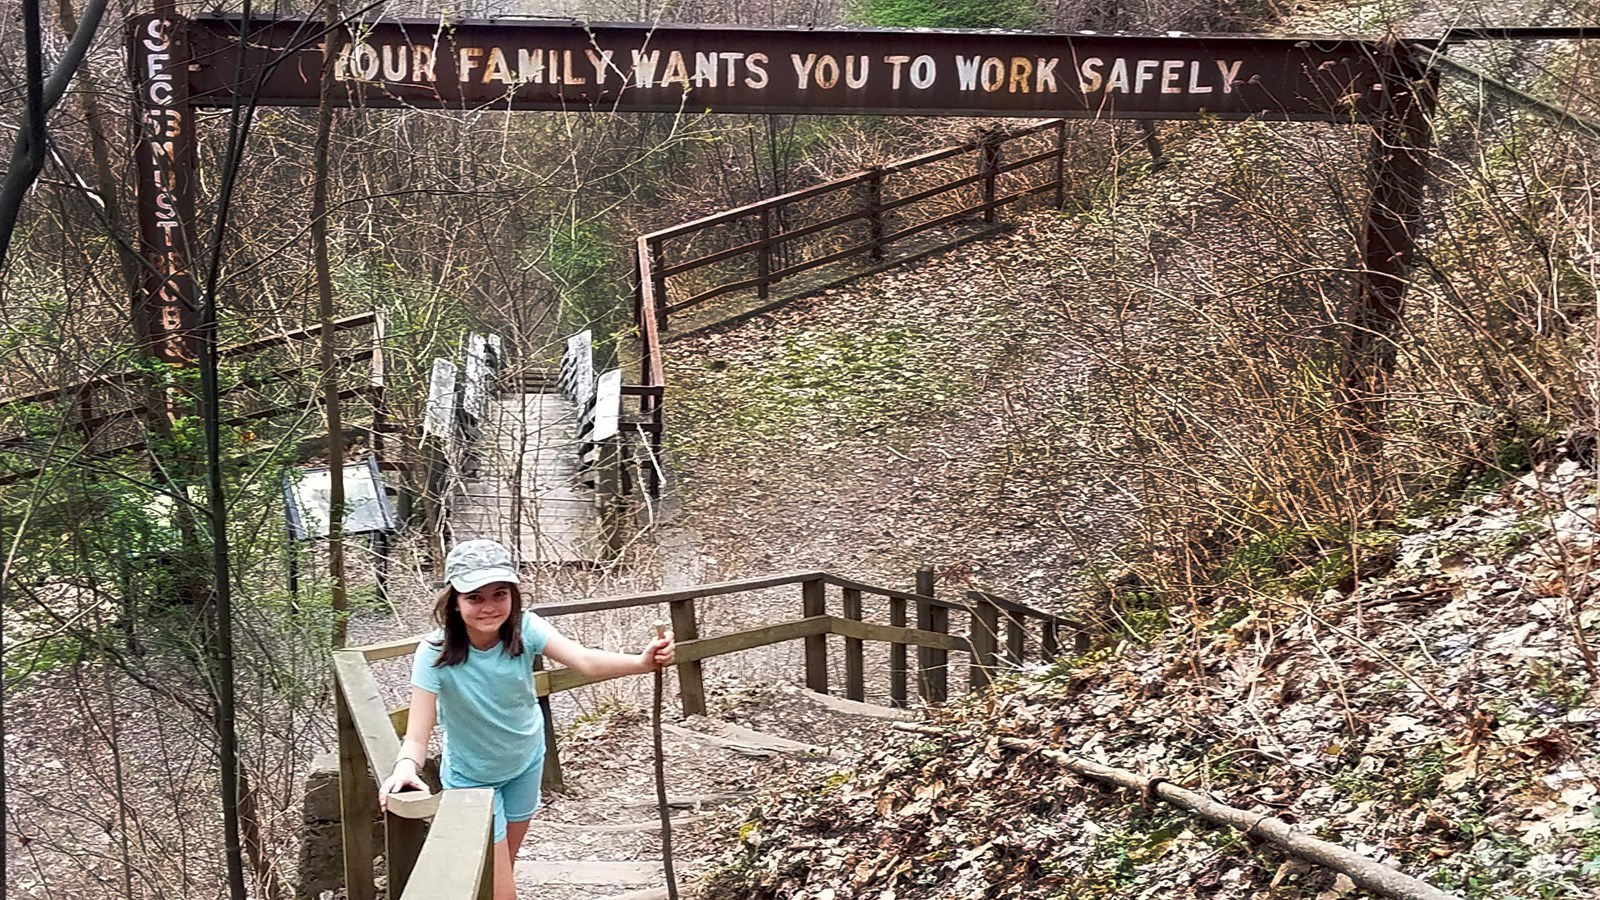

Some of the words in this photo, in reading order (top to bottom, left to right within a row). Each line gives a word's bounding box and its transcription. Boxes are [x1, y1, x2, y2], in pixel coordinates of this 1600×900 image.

[143, 18, 173, 106] SEC
[318, 43, 437, 82] YOUR
[459, 47, 613, 86] FAMILY
[631, 49, 769, 90] WANTS
[790, 53, 869, 91] YOU
[884, 55, 937, 91] TO
[955, 55, 1060, 94] WORK
[1080, 57, 1243, 95] SAFELY
